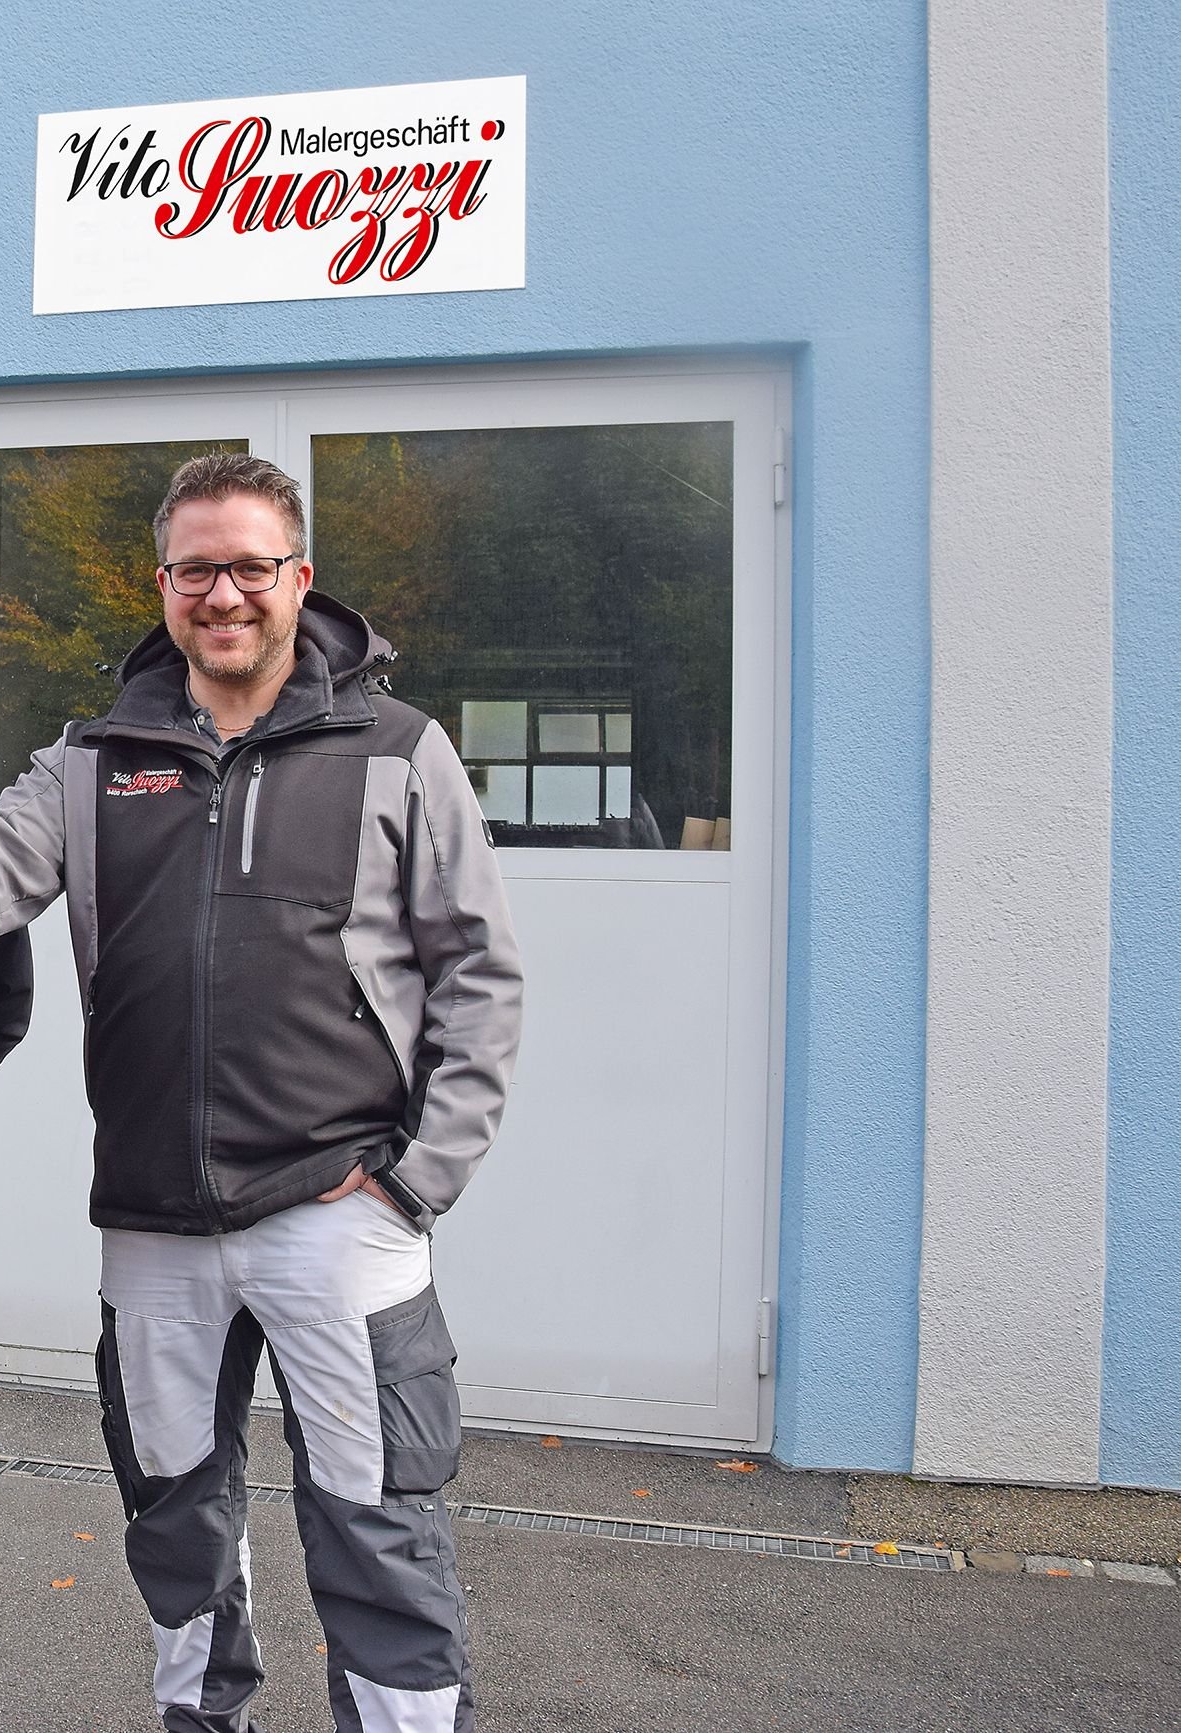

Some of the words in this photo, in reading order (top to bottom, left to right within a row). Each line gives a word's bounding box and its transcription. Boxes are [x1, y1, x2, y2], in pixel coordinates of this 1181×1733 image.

[280, 116, 470, 157] Malergeschäft
[58, 124, 170, 202] Vito
[155, 116, 505, 285] Suozzi
